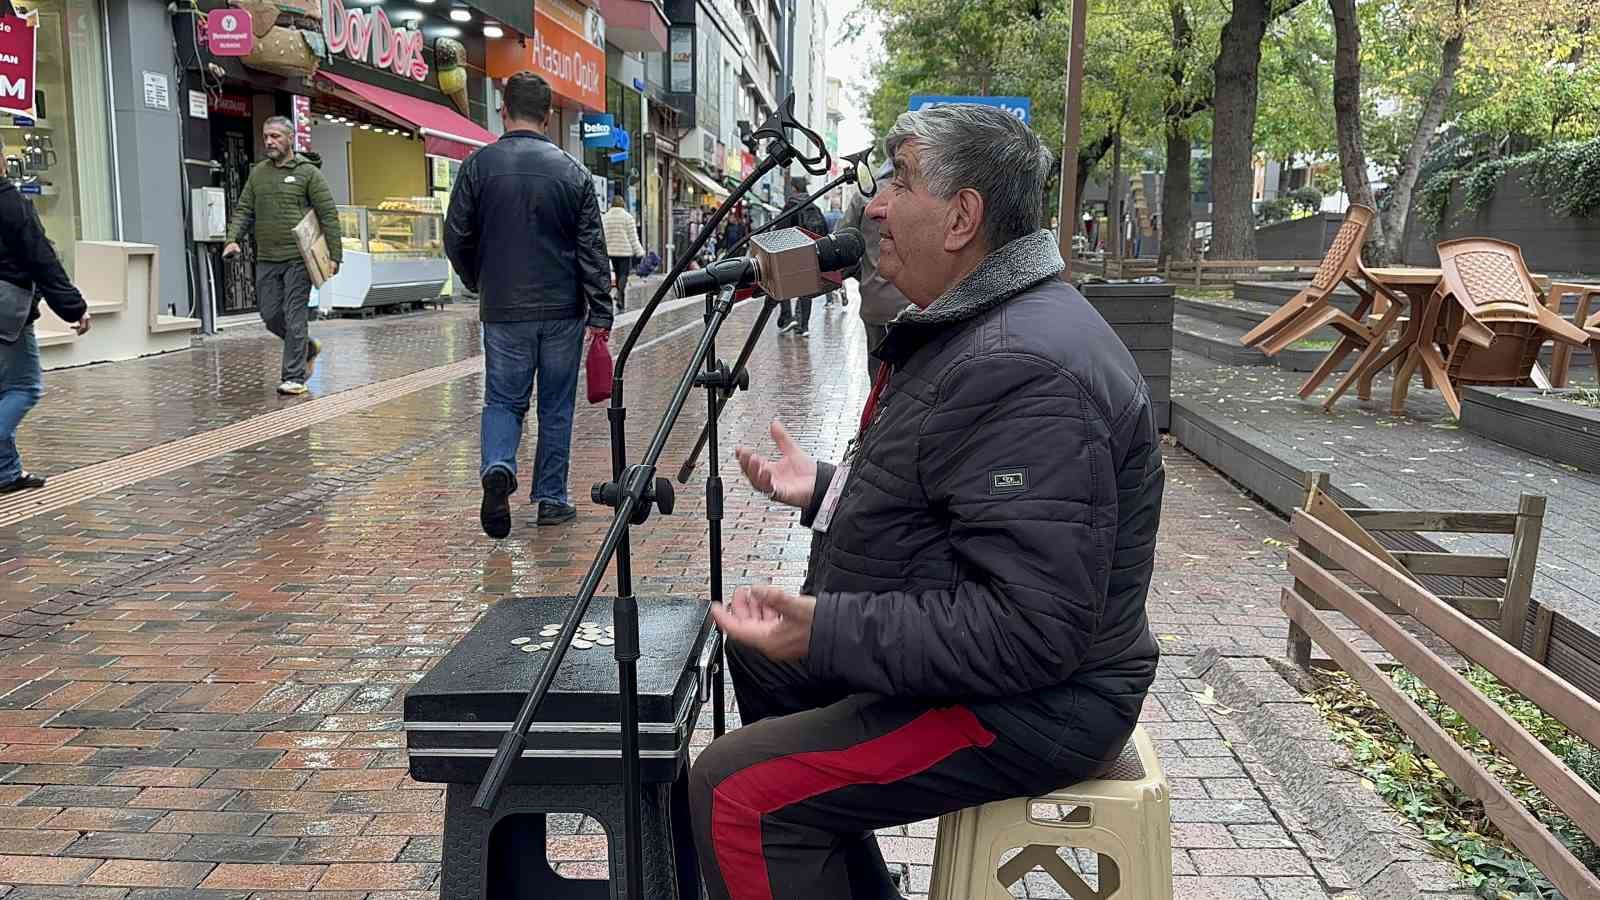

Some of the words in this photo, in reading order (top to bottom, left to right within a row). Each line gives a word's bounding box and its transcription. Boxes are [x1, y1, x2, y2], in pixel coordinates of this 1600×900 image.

[532, 29, 572, 81] Atasun
[574, 51, 600, 96] Optik
[584, 122, 610, 133] beko
